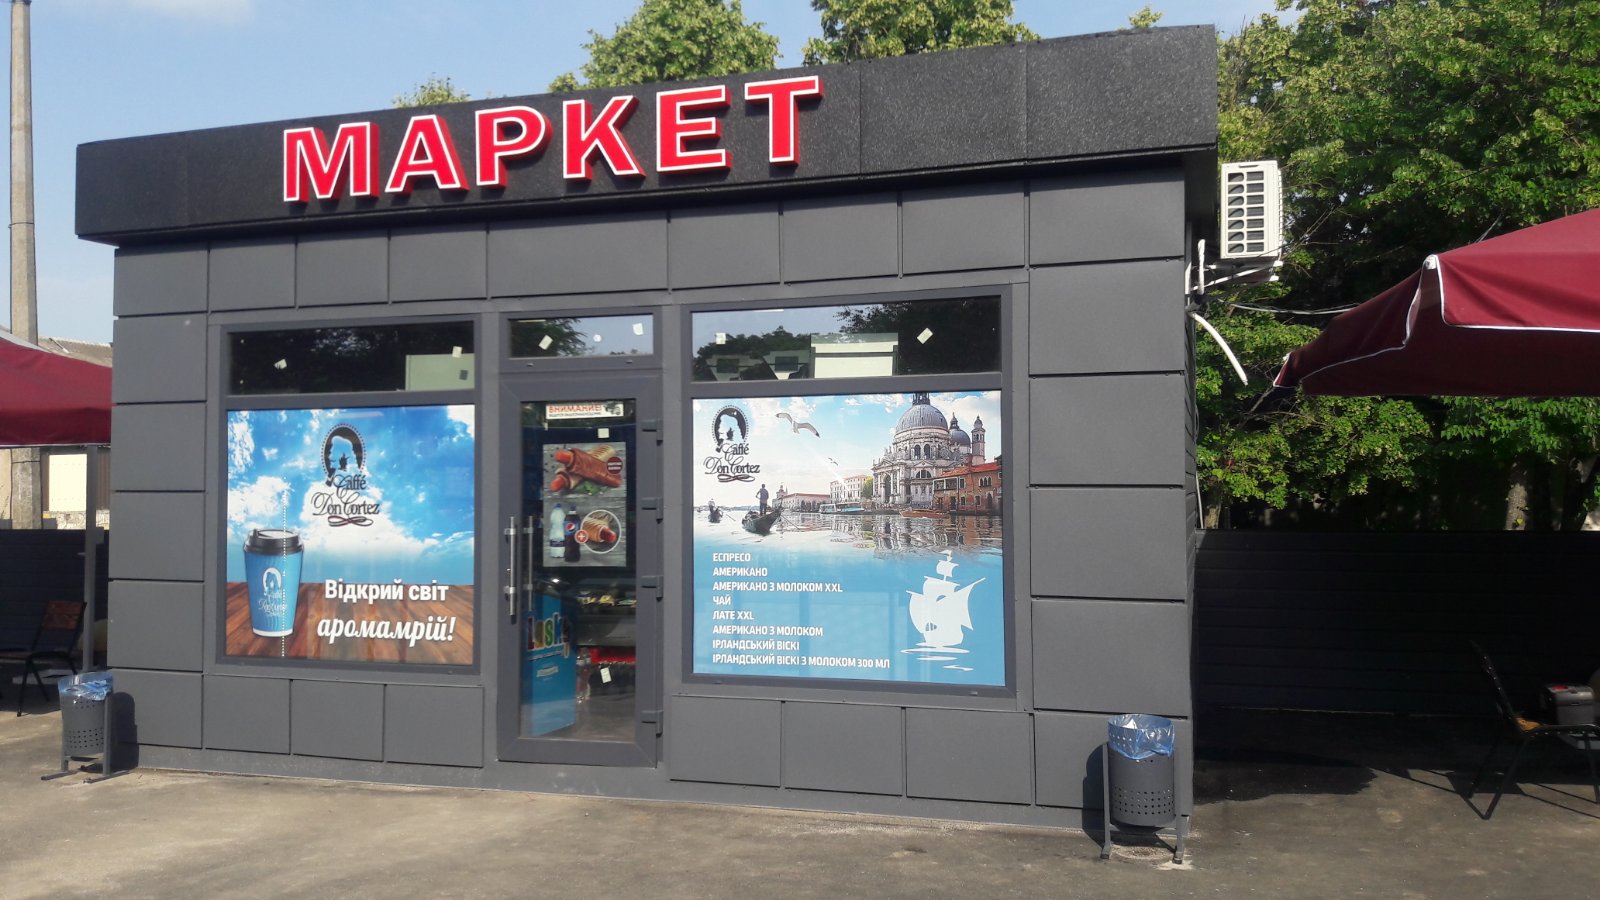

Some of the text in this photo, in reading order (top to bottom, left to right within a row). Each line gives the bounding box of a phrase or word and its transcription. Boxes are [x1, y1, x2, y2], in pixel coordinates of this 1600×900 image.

[284, 75, 823, 203] МАРКЕТ
[703, 455, 761, 475] Don Cortez
[311, 491, 380, 517] Don Cortez
[712, 552, 751, 562] ЕСПРЕСО
[712, 567, 768, 577] АМЕРИКАНО
[324, 578, 450, 605] Відкрий світ
[712, 581, 768, 592] АМЕРИКАНО
[776, 582, 823, 593] МОЛОКОМ
[825, 583, 844, 593] XXL
[712, 594, 732, 606] ЧАЙ
[712, 610, 755, 621] ЛАТЕ XXL
[316, 615, 457, 648] аромамрій!
[712, 625, 768, 636] АМЕРИКАНО
[776, 626, 824, 637] МОЛОКОМ
[712, 639, 800, 651] ІРЛАНДСЬКИЙ ВІСКІ
[712, 653, 775, 665] ІРЛАНДСЬКИЙ
[777, 655, 800, 665] ВІСКІ
[808, 657, 856, 668] МОЛОКОМ
[857, 658, 874, 668] 300
[875, 659, 890, 669] МЛ
